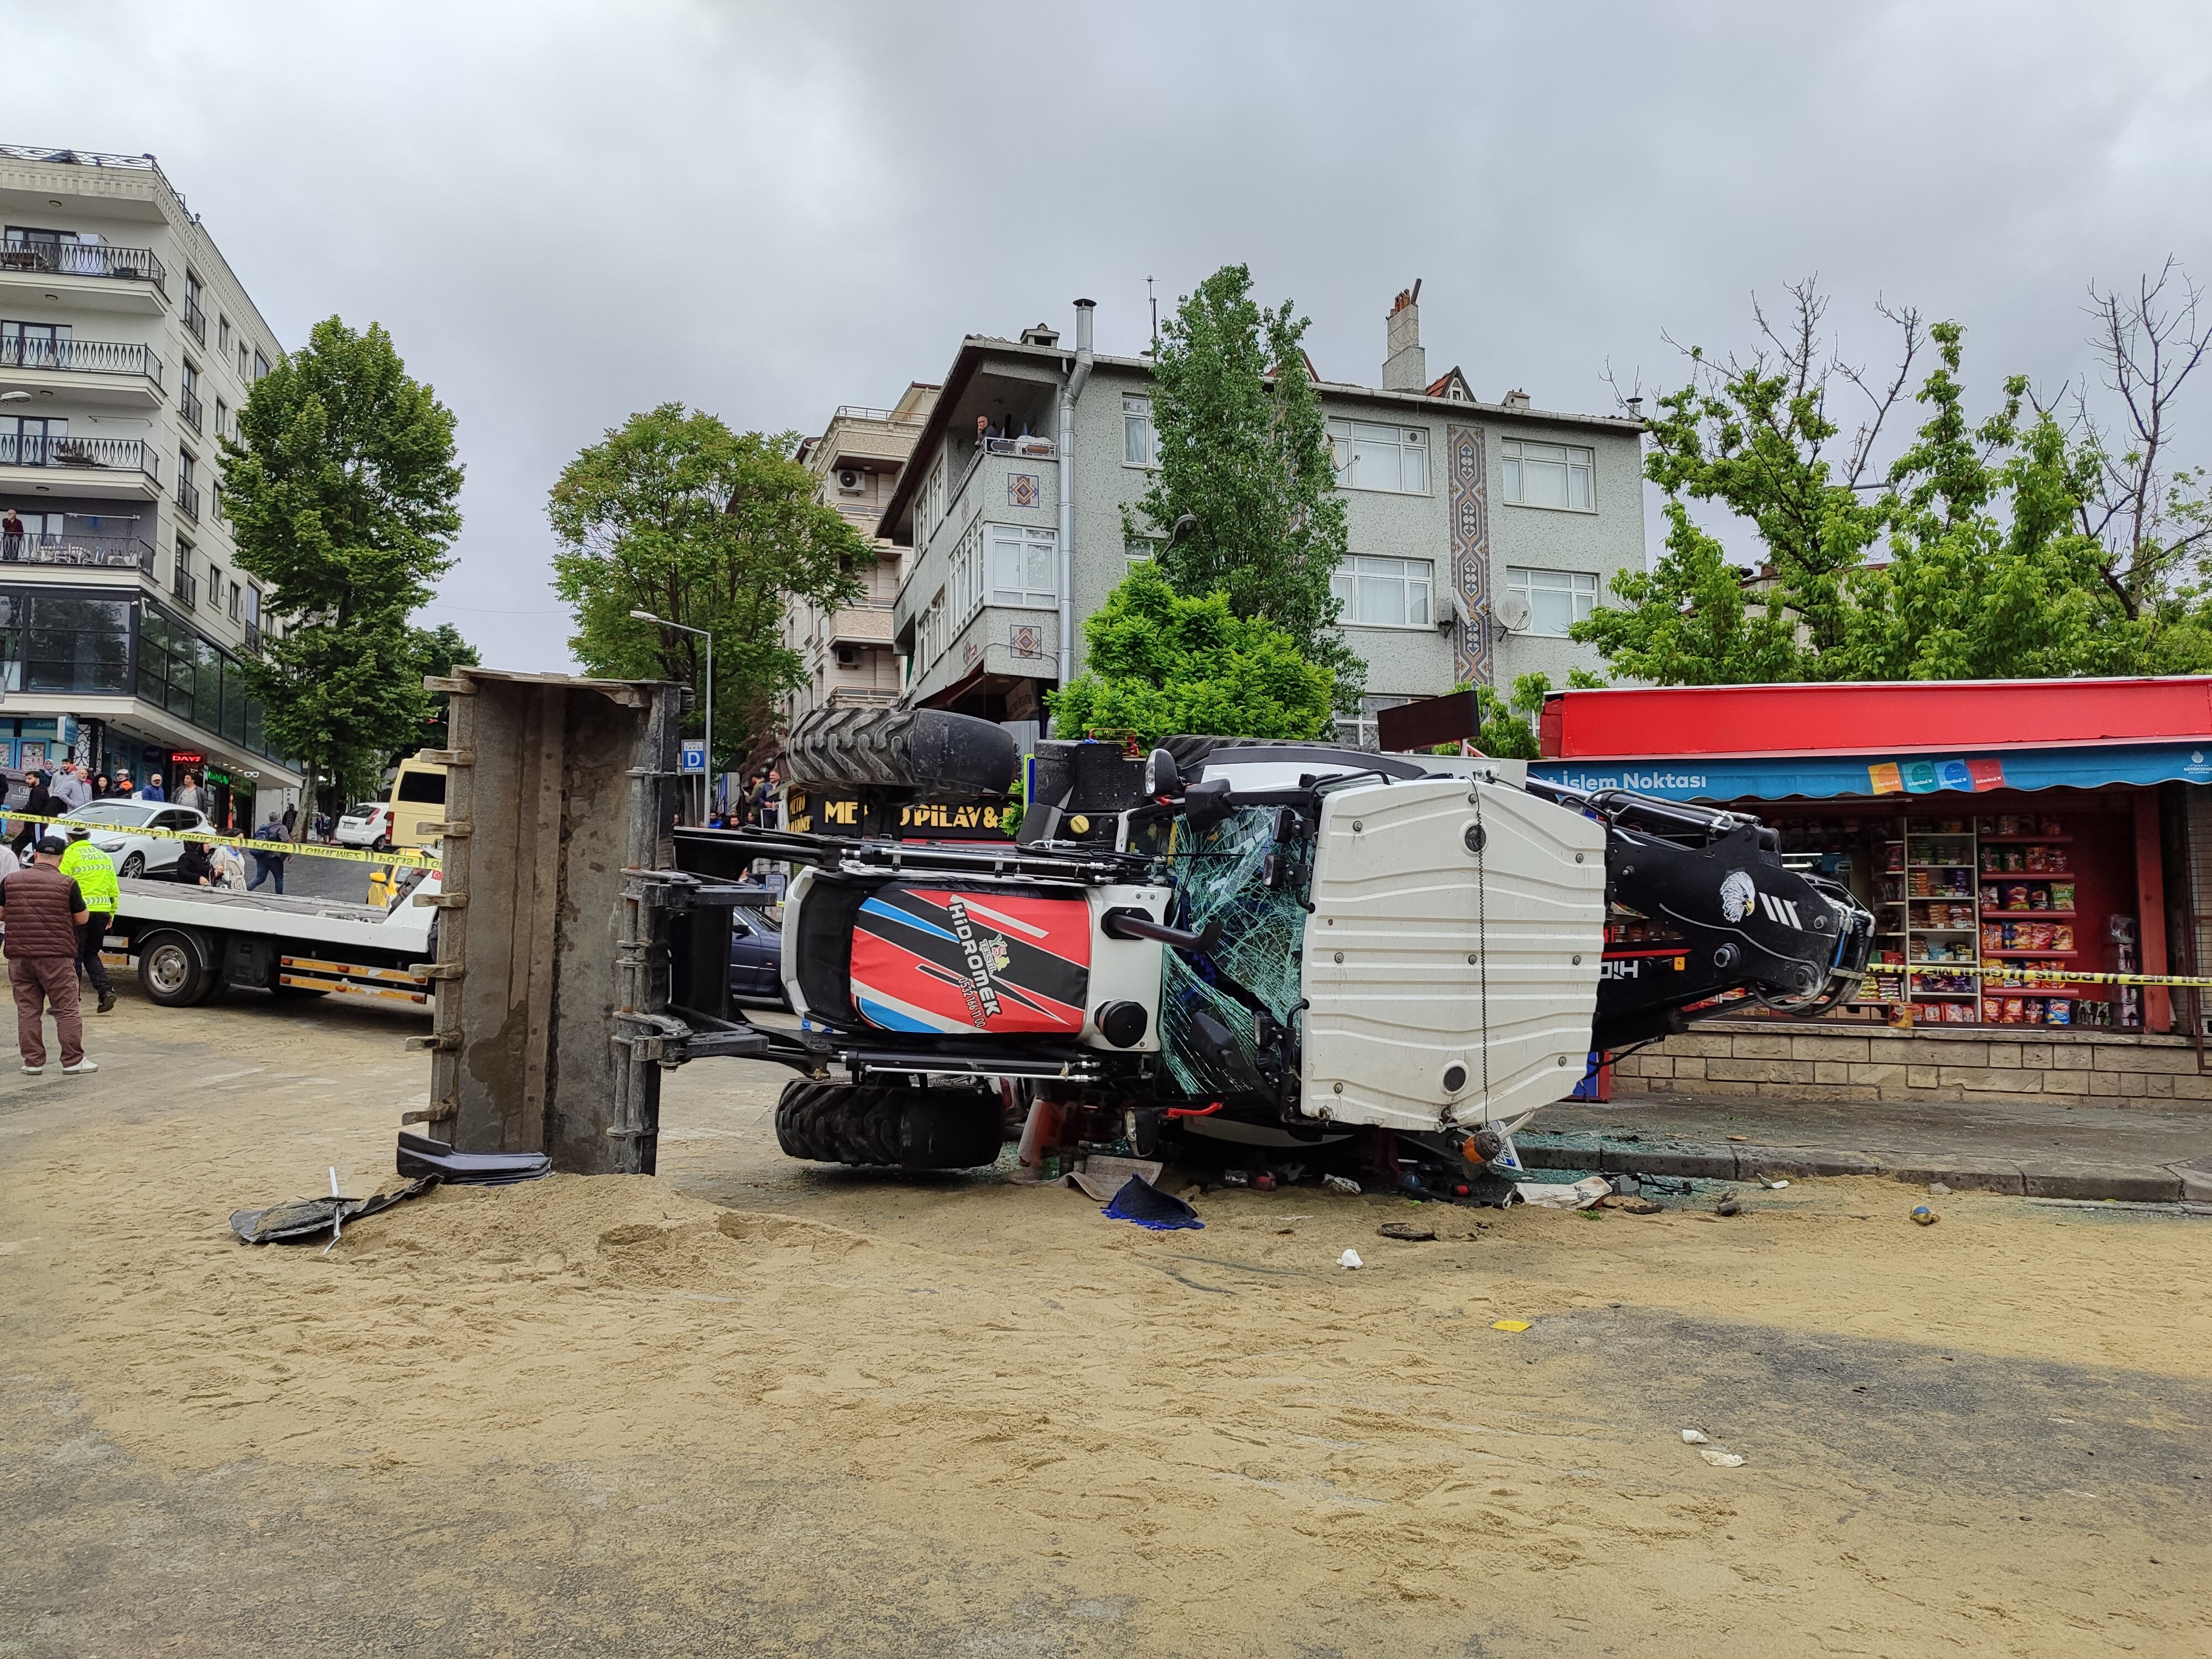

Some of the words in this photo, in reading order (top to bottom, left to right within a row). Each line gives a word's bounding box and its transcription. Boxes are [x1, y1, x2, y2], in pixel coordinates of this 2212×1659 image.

[687, 752, 701, 767] D
[1623, 772, 1707, 789] Noktası
[983, 806, 998, 828] &
[958, 977, 974, 998] 0532
[966, 996, 977, 1010] 166
[974, 1019, 987, 1028] 00
